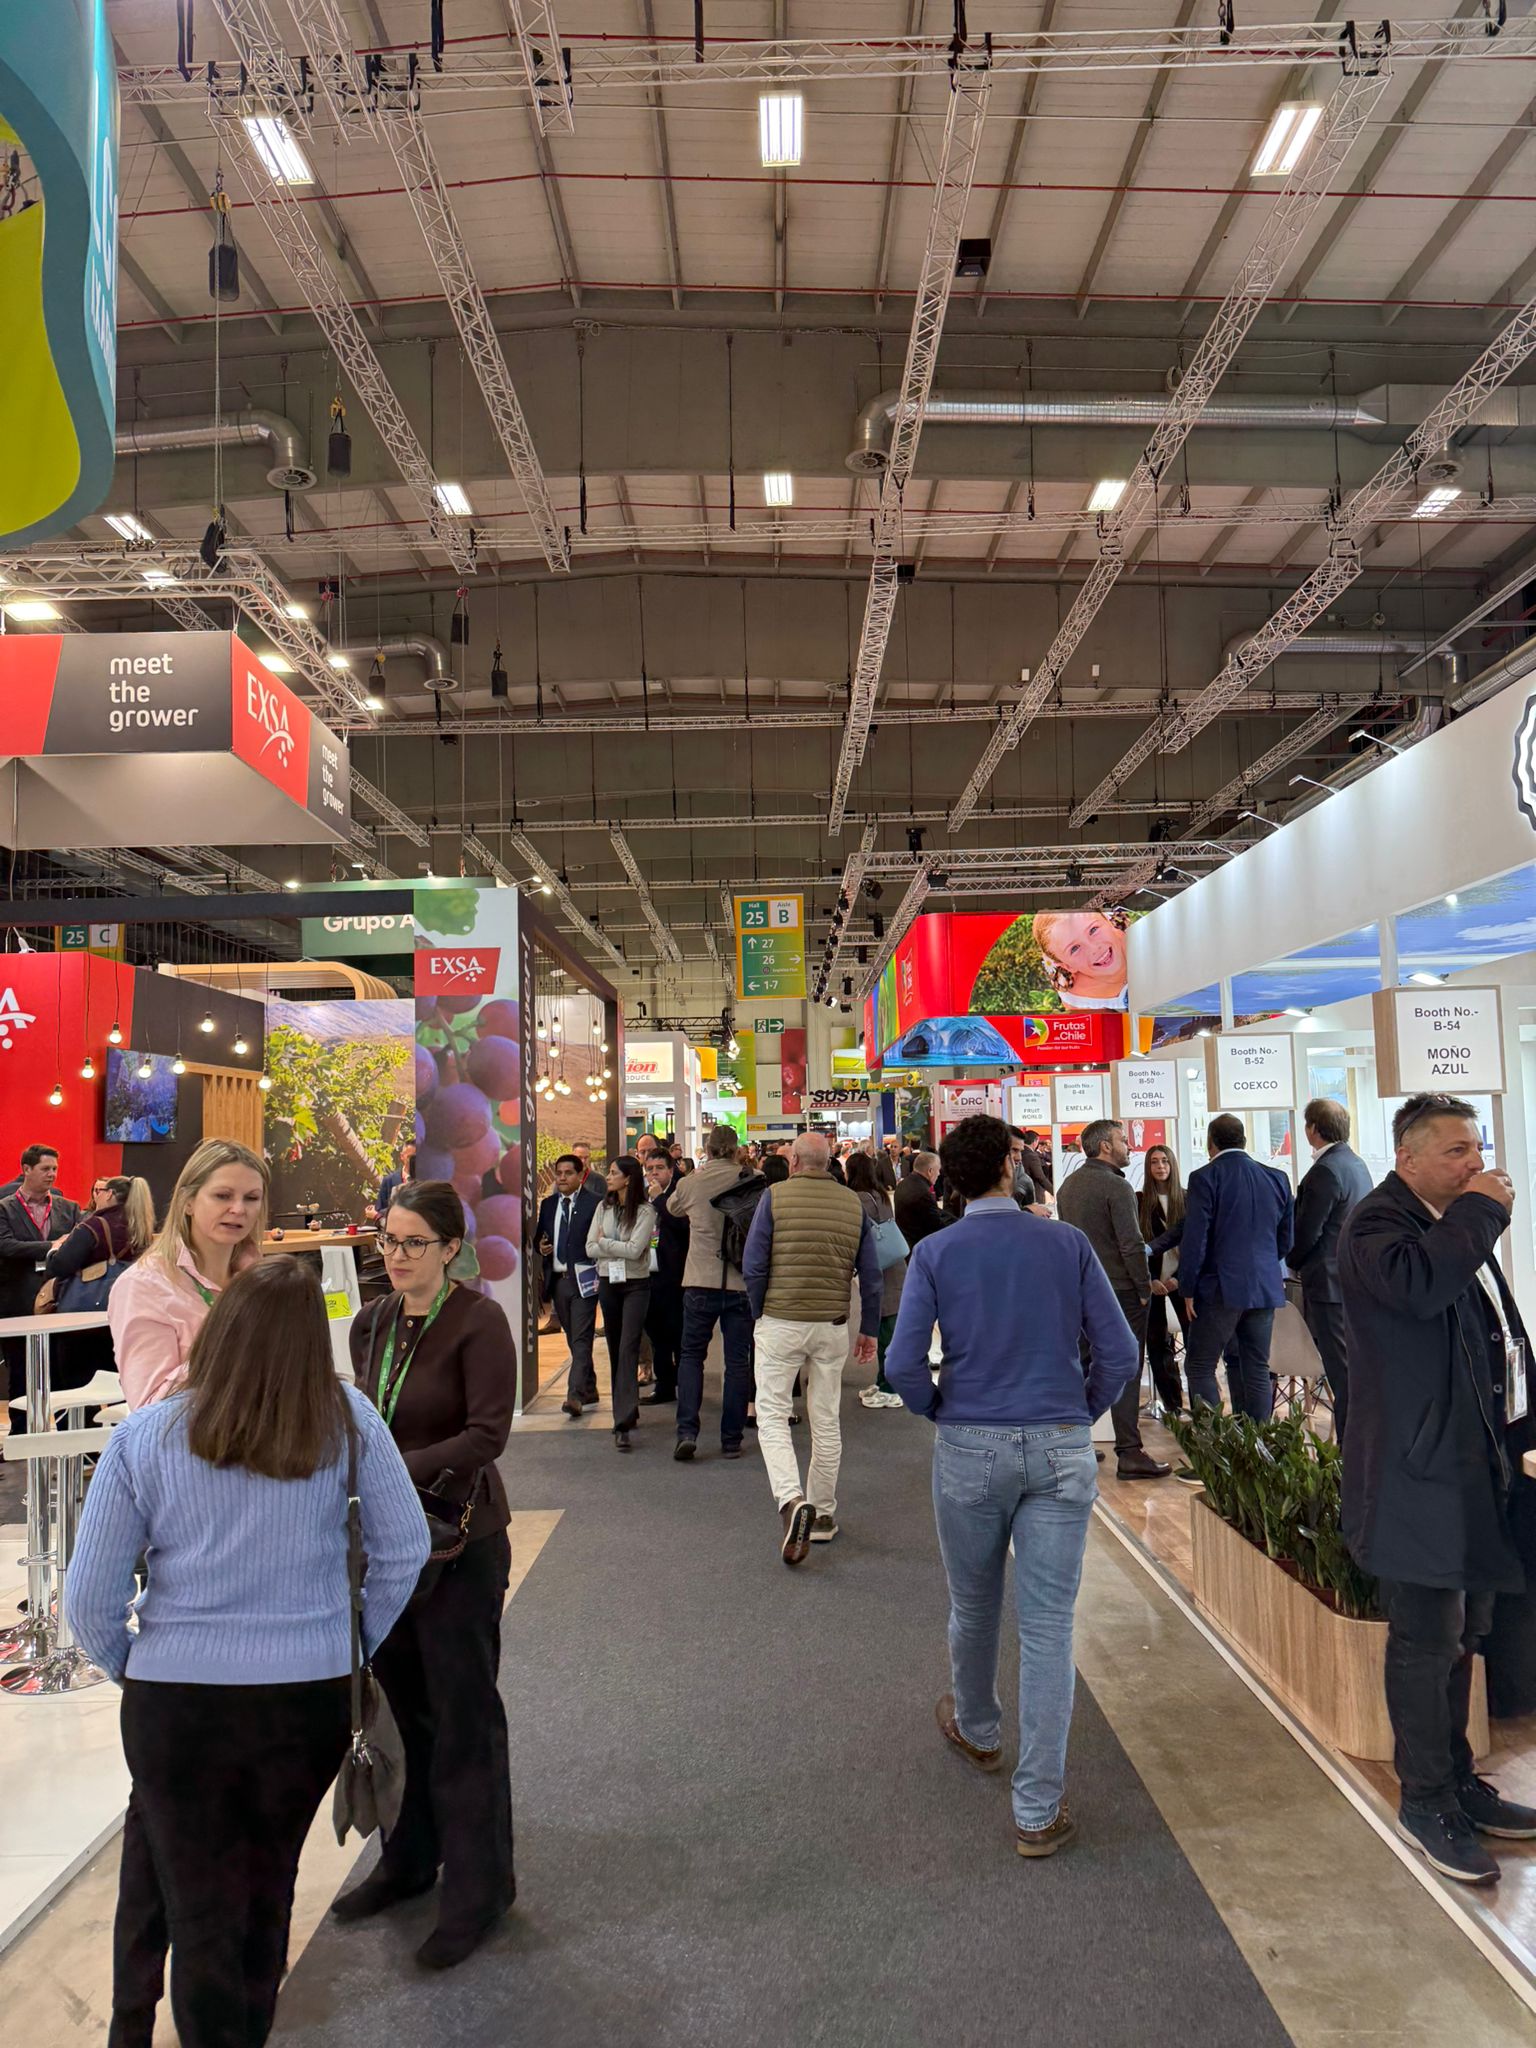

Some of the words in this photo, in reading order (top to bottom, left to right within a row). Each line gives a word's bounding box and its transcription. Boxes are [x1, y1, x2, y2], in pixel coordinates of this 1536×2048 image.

[110, 654, 173, 675] meet
[109, 680, 150, 703] the
[247, 671, 290, 735] EXSA
[109, 708, 199, 732] grower
[322, 744, 338, 771] meet
[322, 764, 334, 788] the
[322, 787, 345, 816] grower
[745, 911, 764, 925] 25
[779, 909, 790, 924] B
[323, 914, 395, 935] Grupo
[399, 914, 414, 928] A
[66, 930, 85, 945] 25
[99, 928, 111, 943] C
[761, 939, 774, 949] 27
[431, 956, 484, 975] EXSA
[762, 955, 775, 965] 26
[1414, 1007, 1450, 1018] Booth
[1454, 1006, 1479, 1017] No.-
[1053, 1021, 1086, 1031] Frutas
[1434, 1020, 1461, 1031] B-54
[1060, 1031, 1086, 1041] Chile
[1231, 1047, 1257, 1056] Booth
[1259, 1047, 1278, 1055] No.-
[1427, 1045, 1471, 1060] MOÑO
[625, 1059, 657, 1073] ion
[1244, 1057, 1265, 1065] B-52
[1432, 1063, 1469, 1075] AZUL
[1233, 1080, 1278, 1090] COEXCO
[812, 1088, 870, 1103] SUSTA
[961, 1097, 983, 1106] DRC
[1131, 1092, 1165, 1100] GLOBAL
[1065, 1104, 1094, 1112] EMELKA
[1134, 1100, 1162, 1108] FRESH
